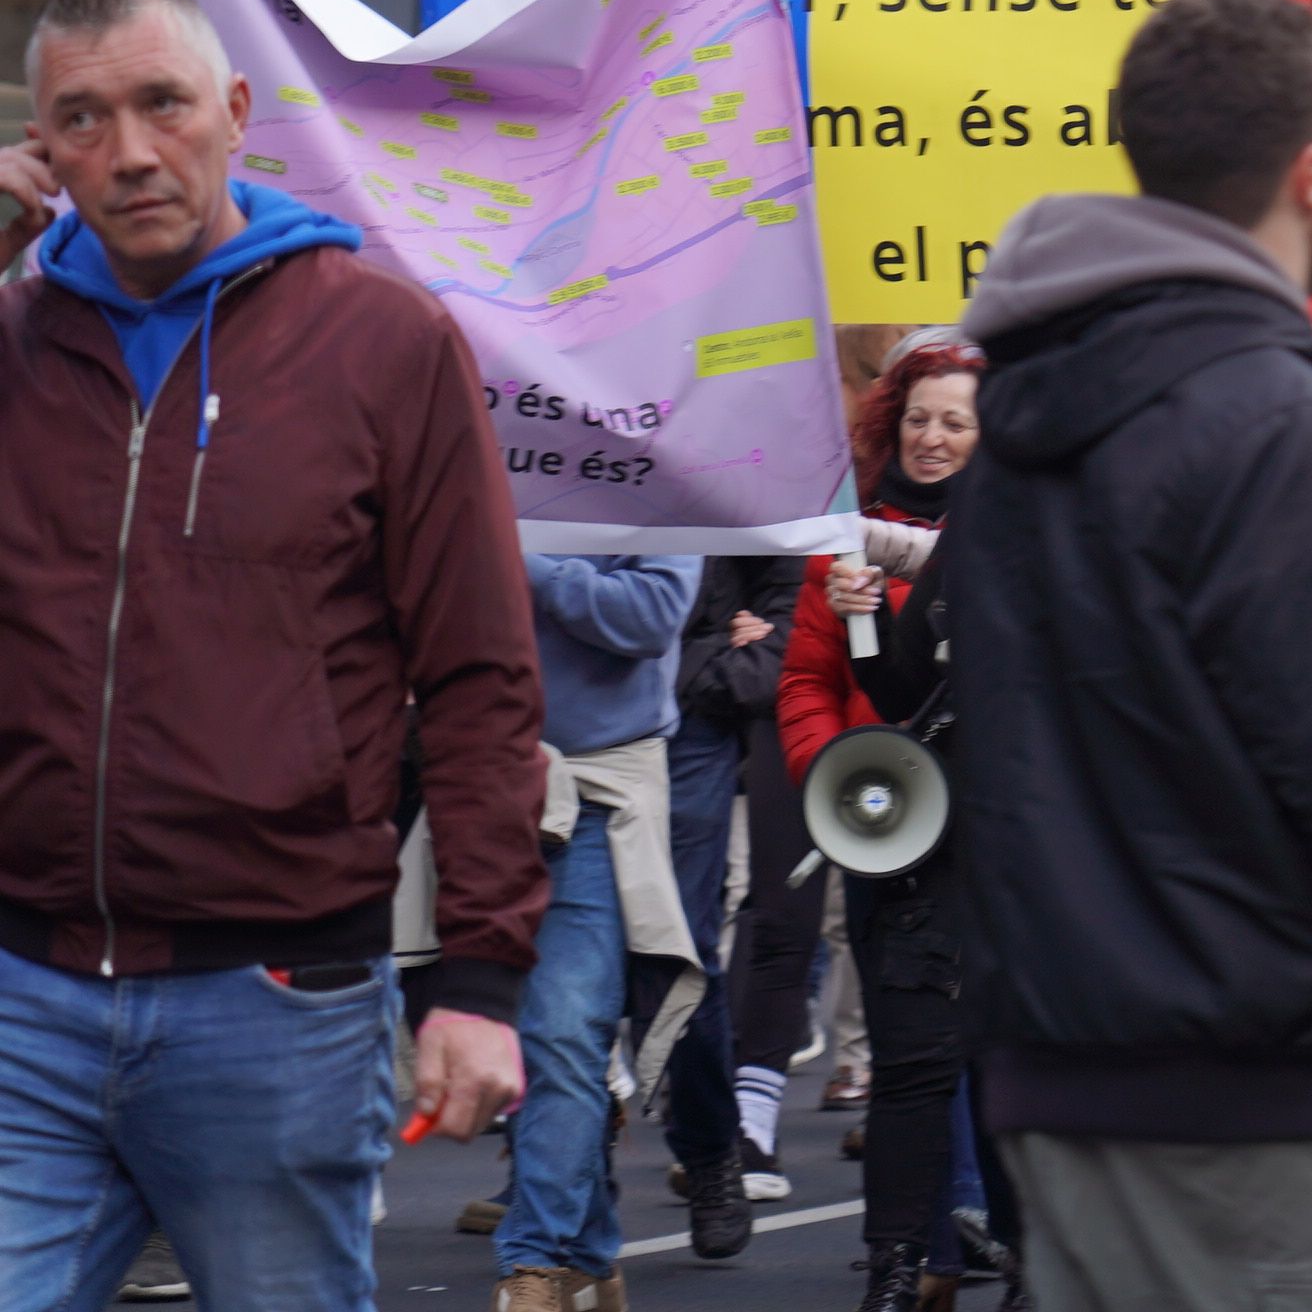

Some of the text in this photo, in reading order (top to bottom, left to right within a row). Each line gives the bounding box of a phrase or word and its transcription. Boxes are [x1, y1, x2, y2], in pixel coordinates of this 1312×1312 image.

[960, 89, 1030, 147] és
[873, 226, 927, 283] el
[516, 383, 566, 422] és
[580, 450, 655, 487] és?
